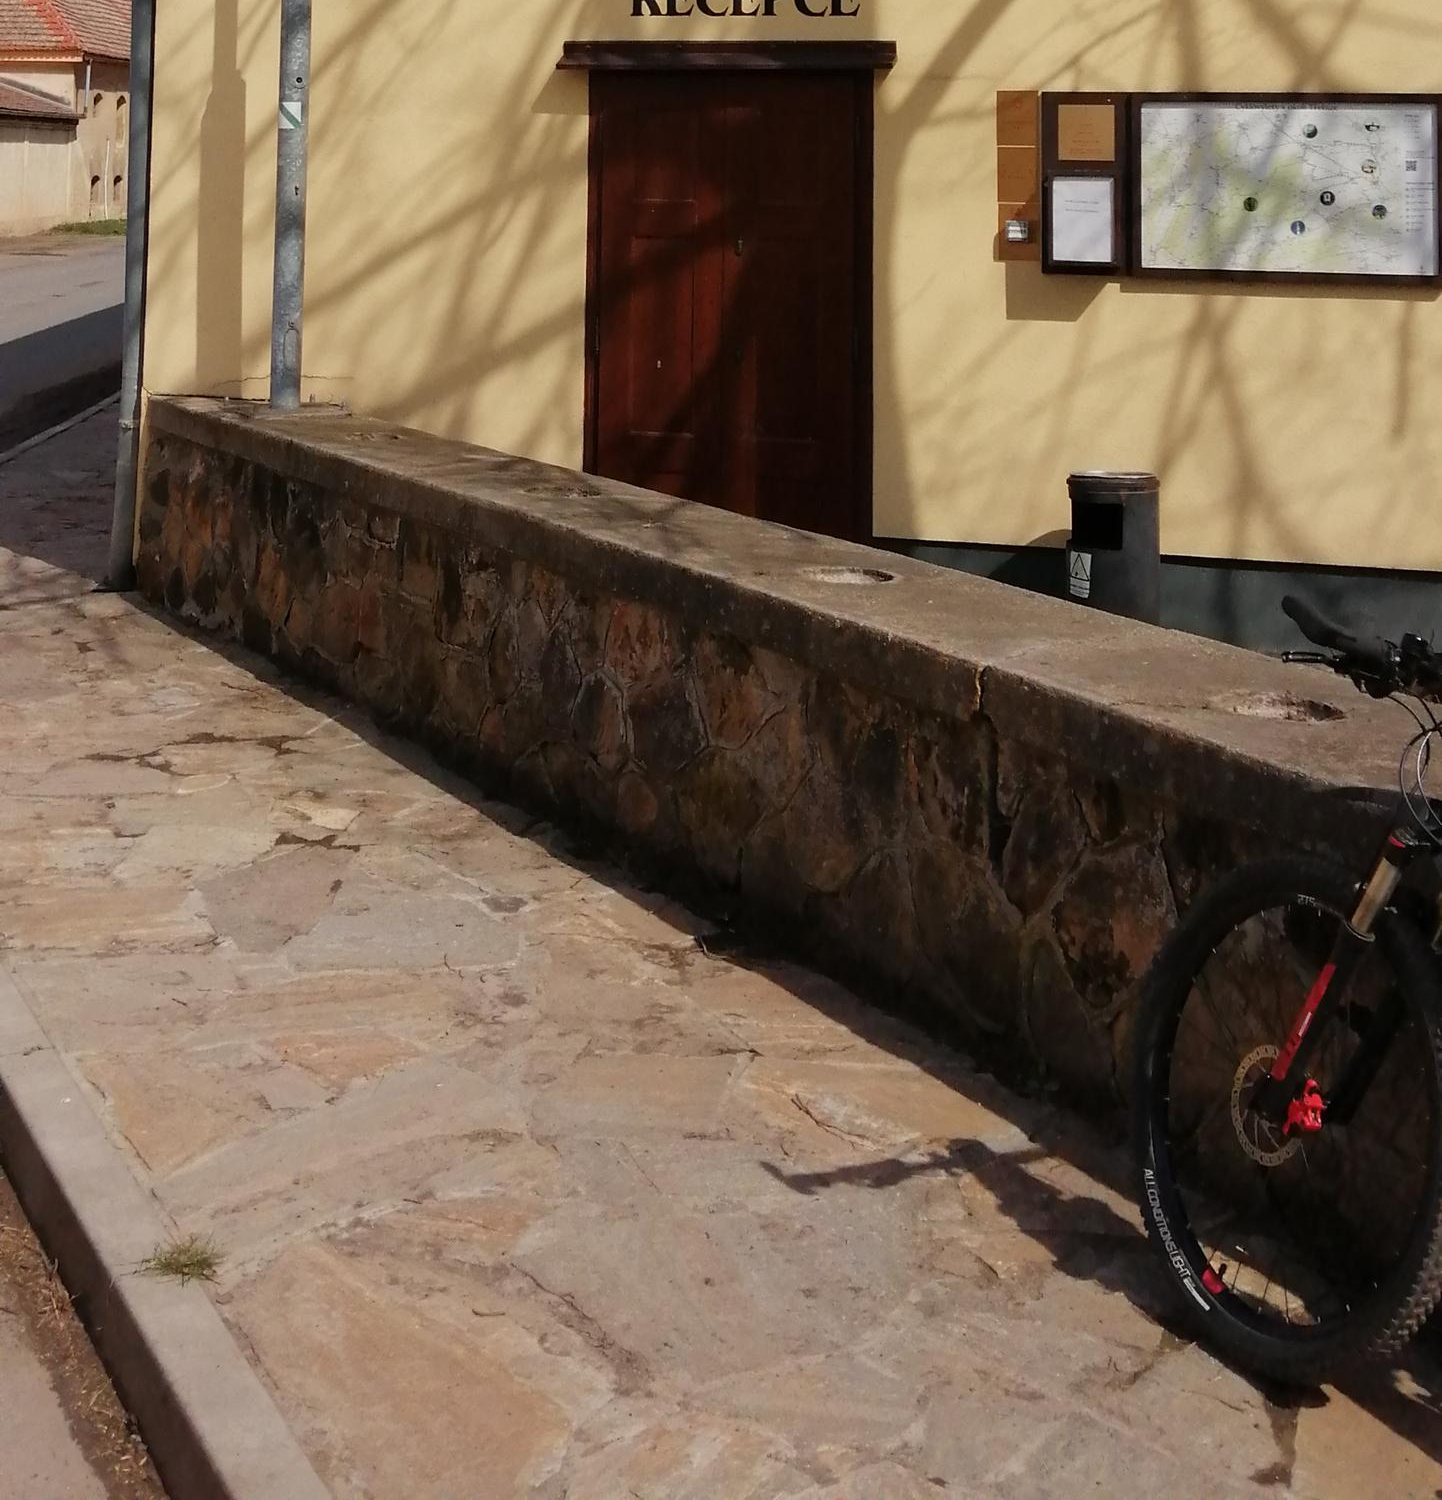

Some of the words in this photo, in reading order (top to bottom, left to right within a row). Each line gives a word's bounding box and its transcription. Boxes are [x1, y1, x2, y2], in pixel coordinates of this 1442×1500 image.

[1144, 1168, 1156, 1187] ALL
[1147, 1188, 1177, 1252] CONDITIONS
[1169, 1250, 1191, 1277] LIGHT
